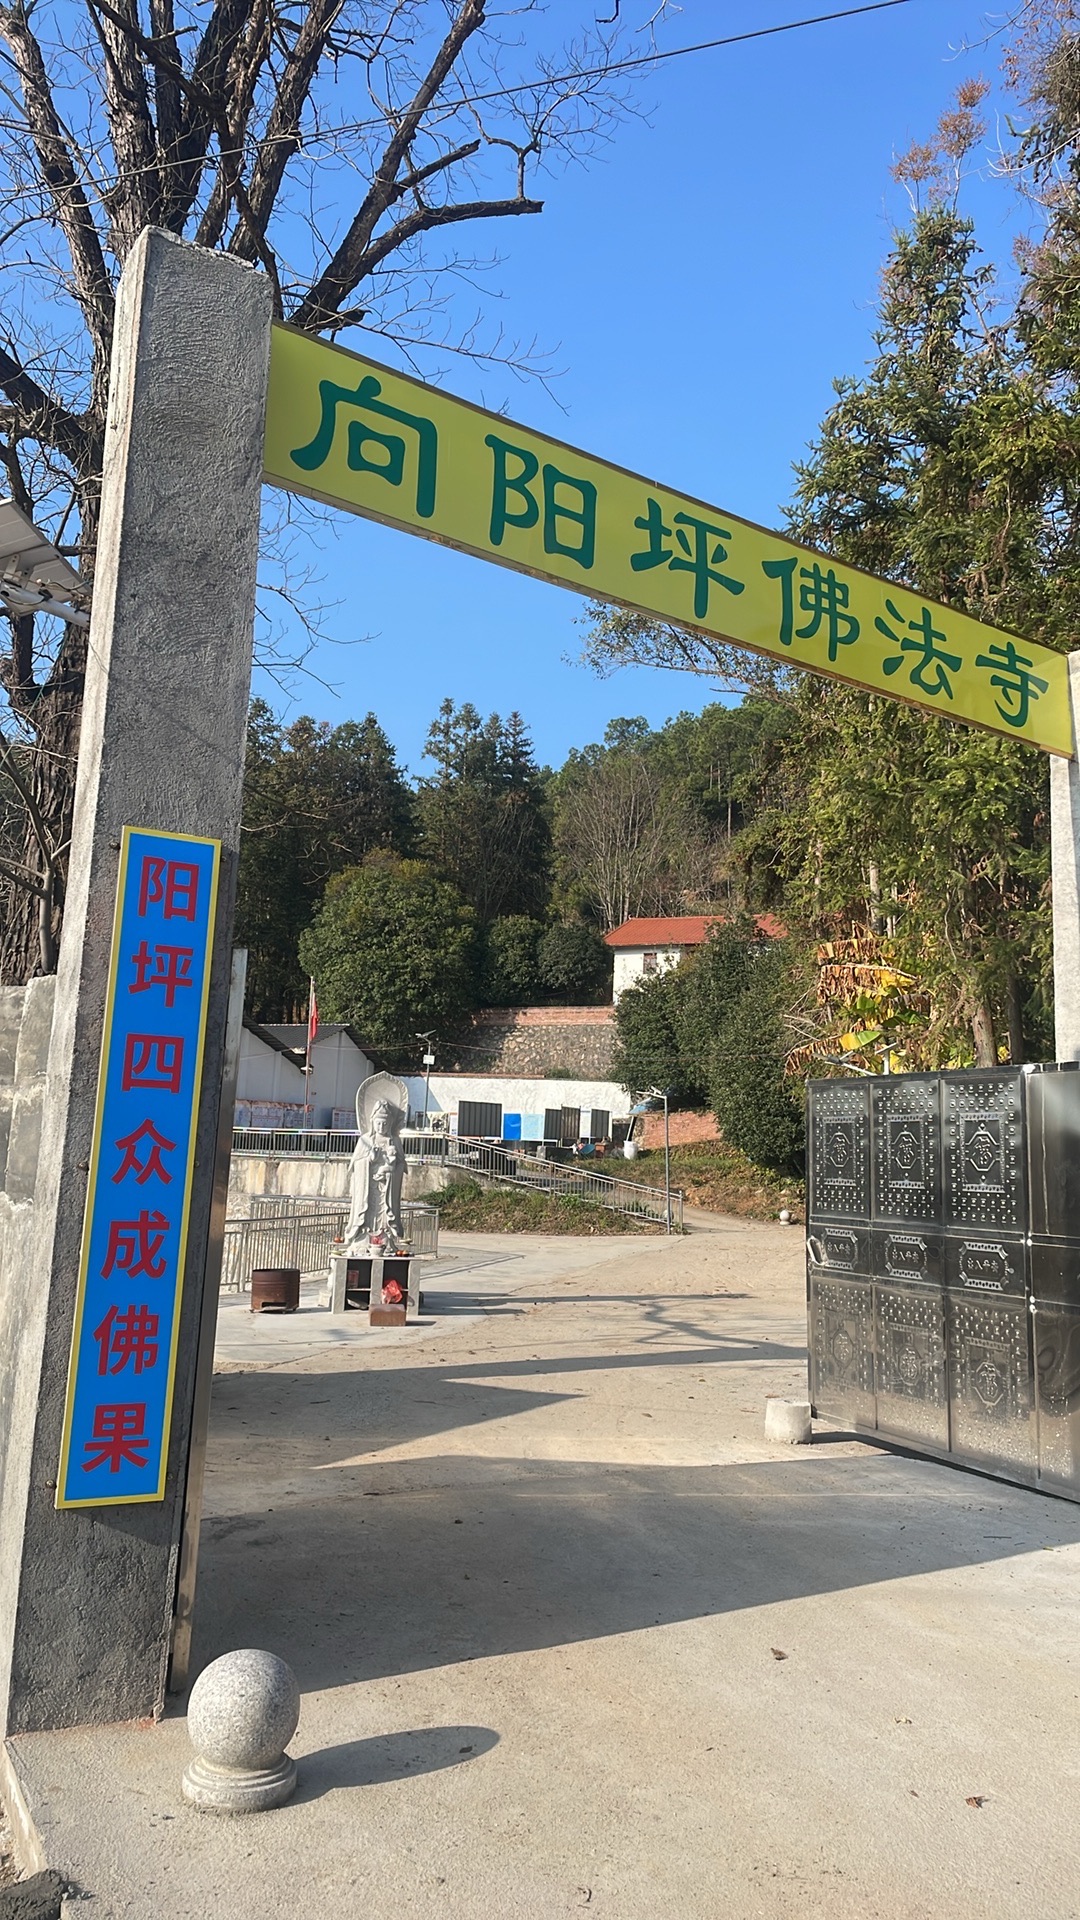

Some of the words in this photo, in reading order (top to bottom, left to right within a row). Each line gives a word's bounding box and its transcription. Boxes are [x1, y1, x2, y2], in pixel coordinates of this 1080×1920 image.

[290, 375, 1048, 728] 向阳坪佛法寺
[81, 855, 200, 1475] 阳坪四众成佛果
